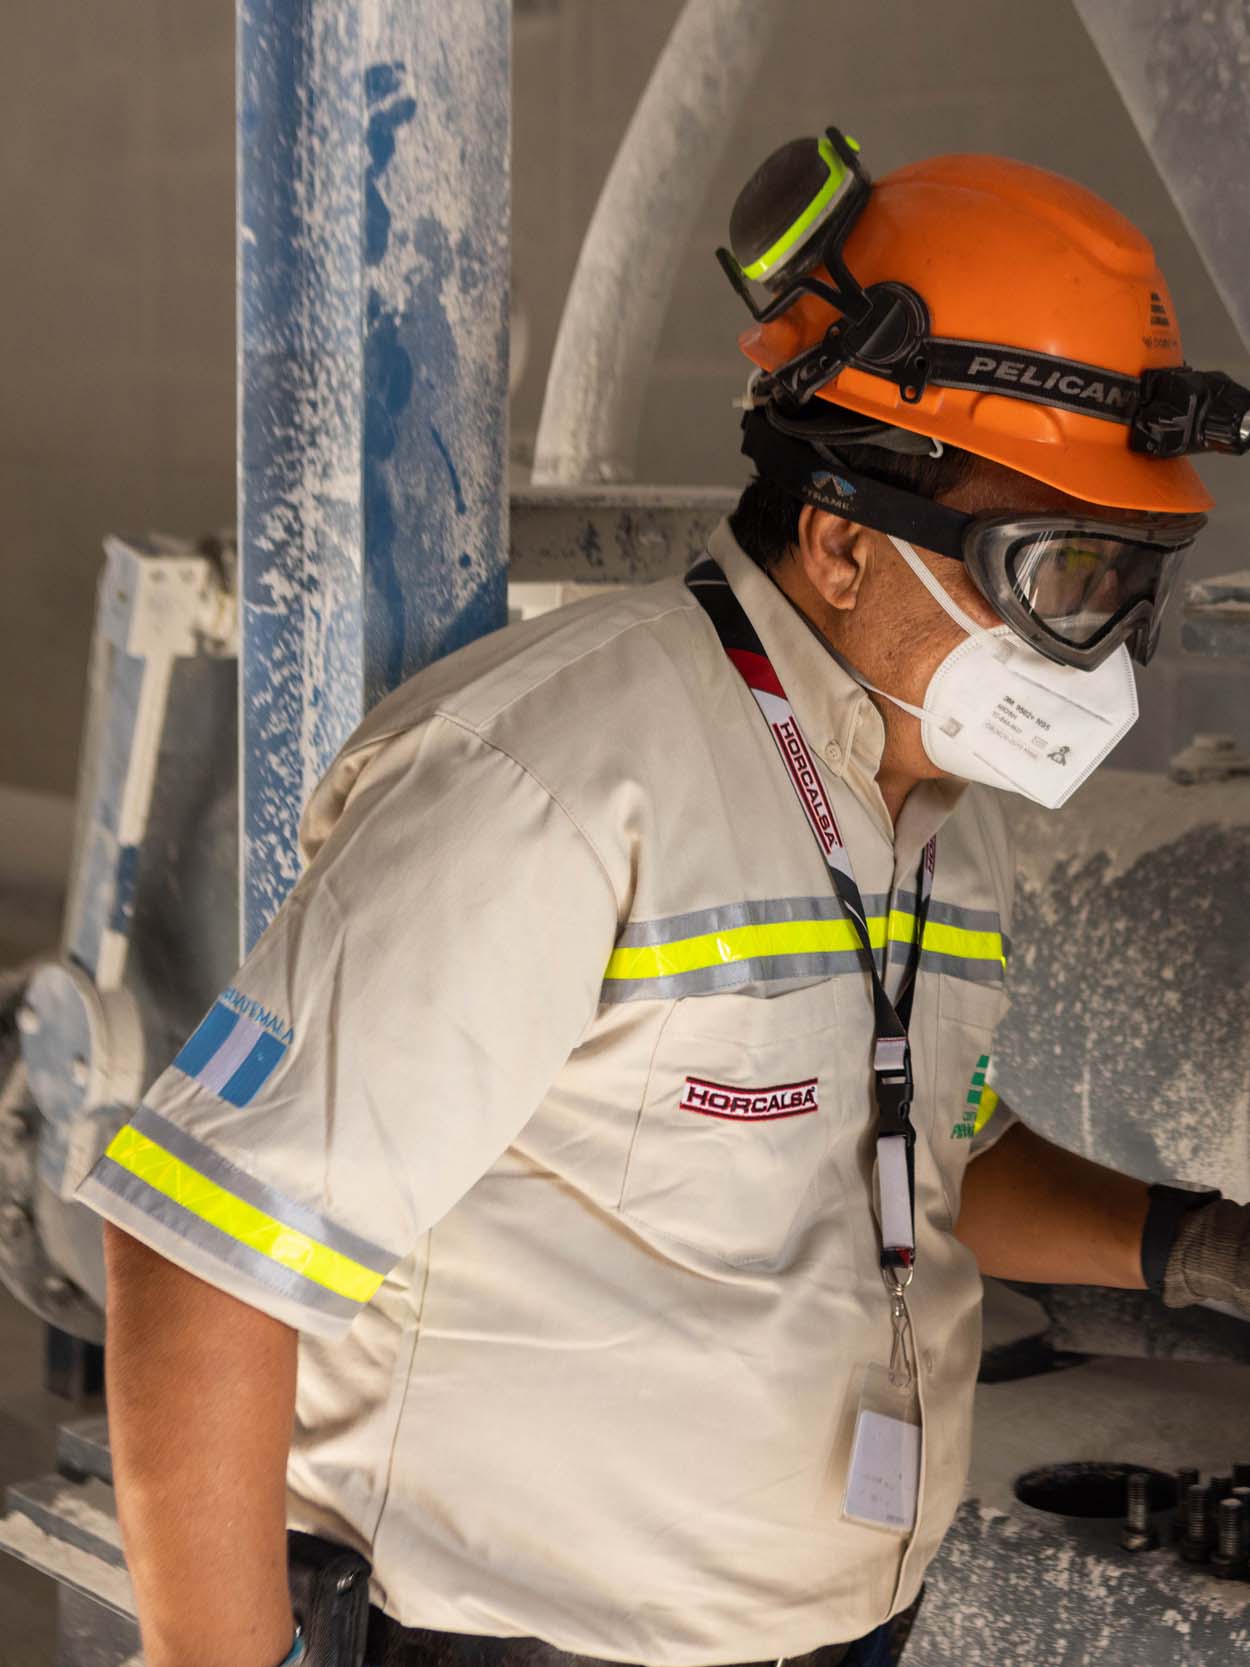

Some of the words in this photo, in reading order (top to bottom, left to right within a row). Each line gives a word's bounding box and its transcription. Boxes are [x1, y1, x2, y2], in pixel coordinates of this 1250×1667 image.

[967, 356, 1134, 407] PELICAN
[780, 721, 837, 848] HORCALSA
[686, 1085, 815, 1114] HORCALSA
